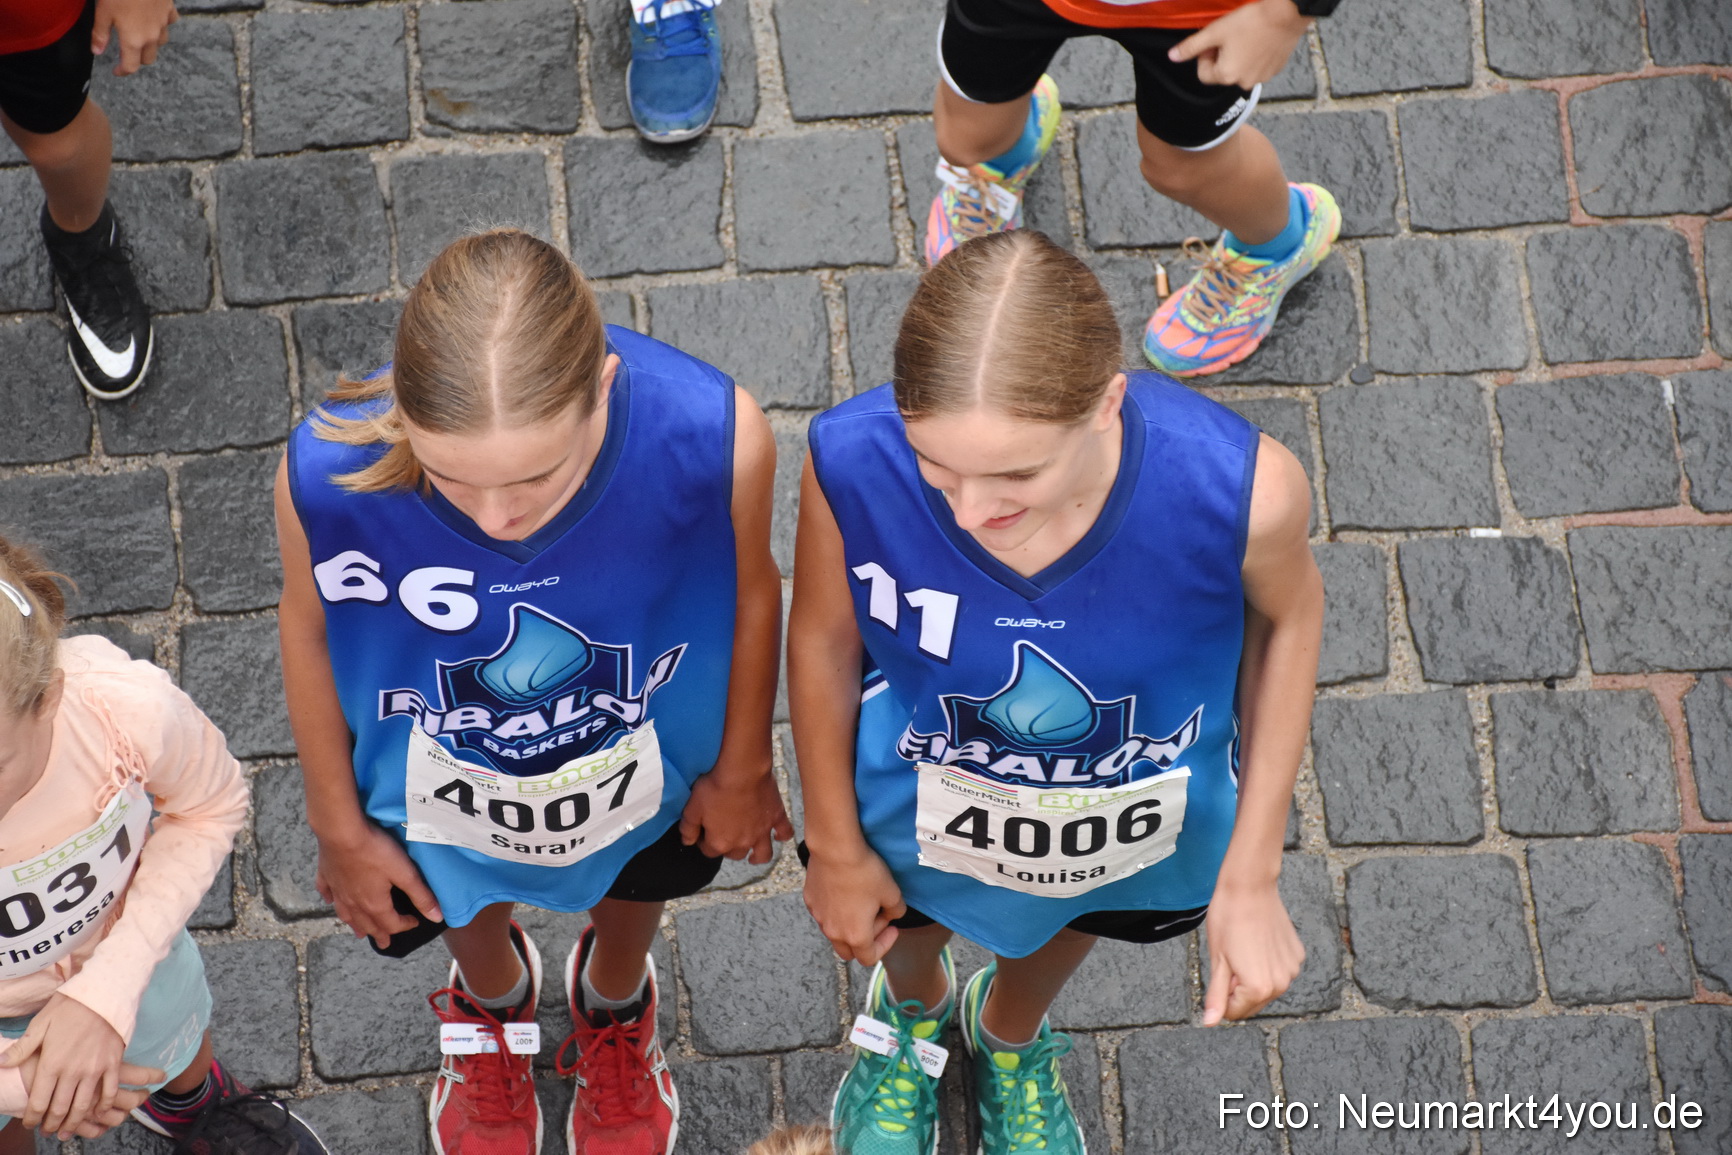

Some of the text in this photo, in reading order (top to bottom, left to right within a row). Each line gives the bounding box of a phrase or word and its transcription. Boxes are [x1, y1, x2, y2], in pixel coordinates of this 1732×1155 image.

[313, 550, 480, 632] 66
[851, 561, 960, 660] 11
[482, 716, 608, 761] BASKETS
[517, 740, 638, 794] BOCK
[433, 759, 638, 833] 4007
[941, 777, 1022, 809] NeuerMarkt
[12, 796, 130, 882] BOCK
[490, 833, 586, 855] Sarah
[929, 833, 938, 843] J
[945, 798, 1162, 858] 4006
[0, 823, 132, 938] 031
[996, 863, 1106, 884] Louisa
[515, 1038, 533, 1046] 4007
[920, 1055, 939, 1067] 4006
